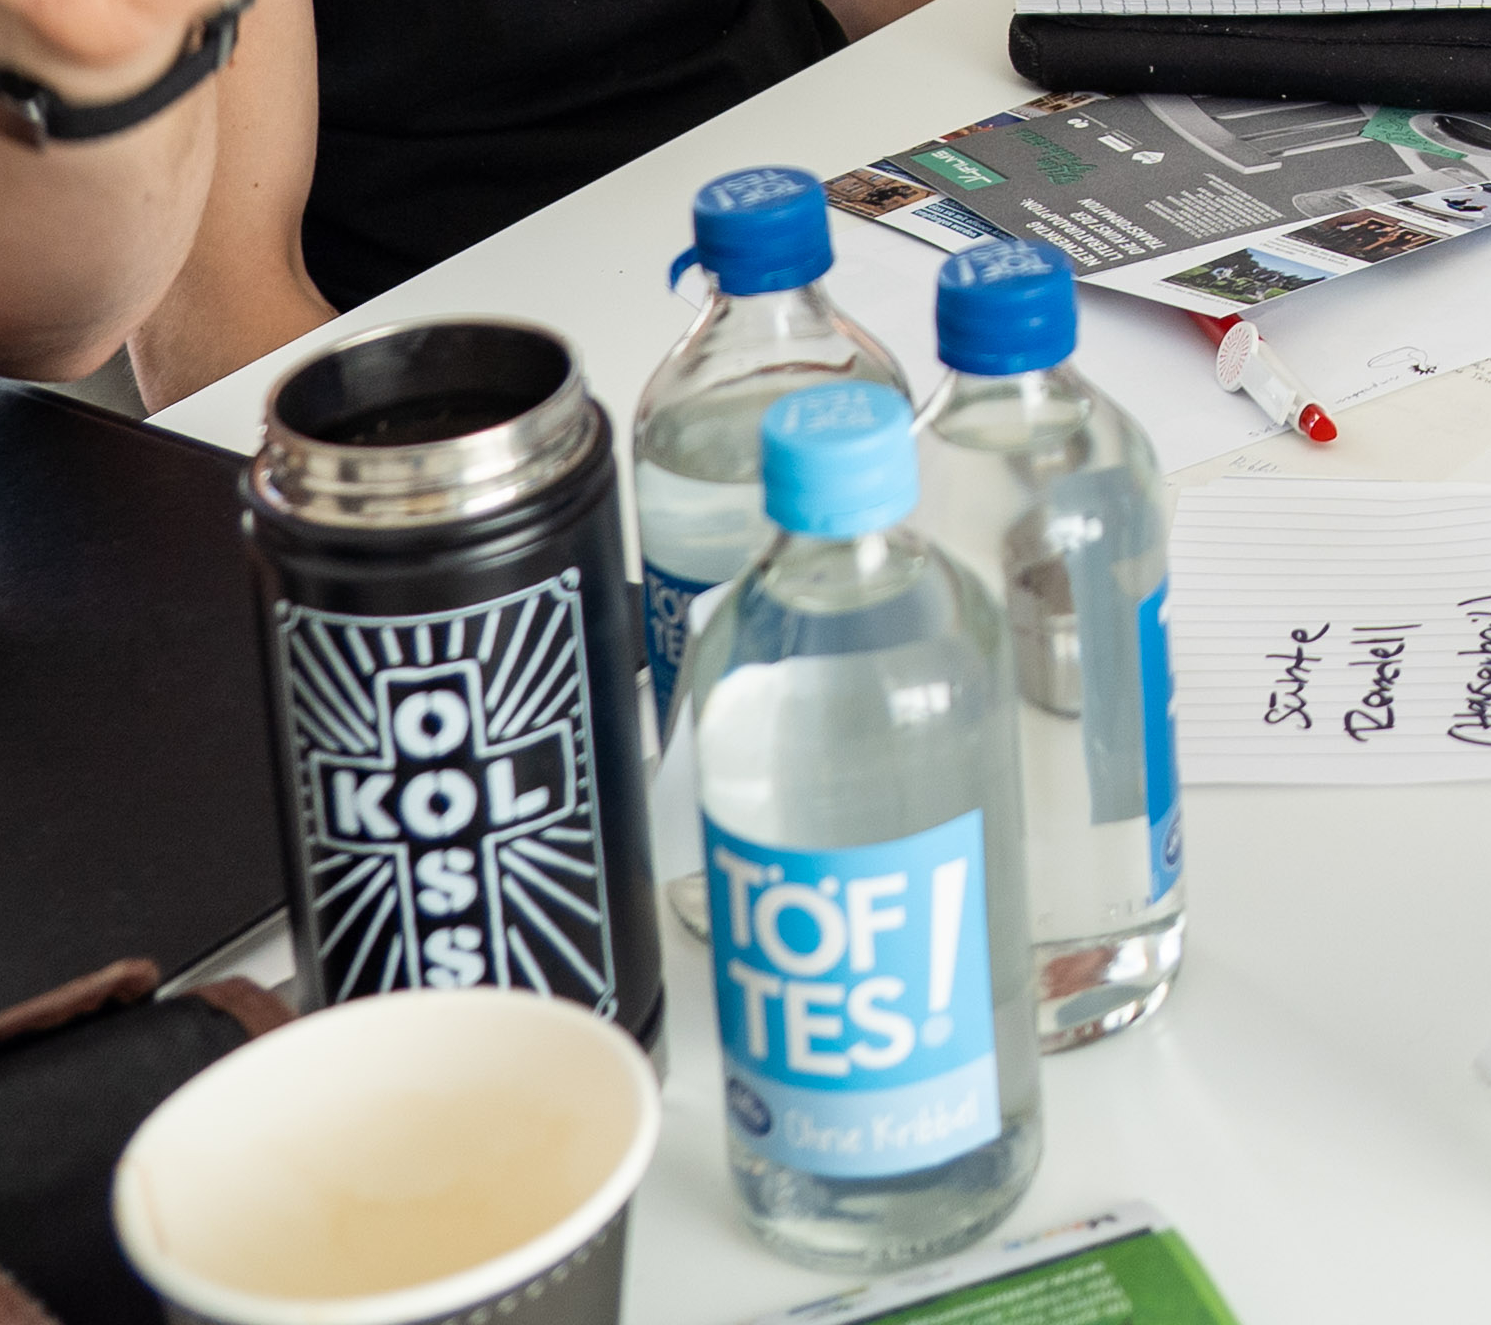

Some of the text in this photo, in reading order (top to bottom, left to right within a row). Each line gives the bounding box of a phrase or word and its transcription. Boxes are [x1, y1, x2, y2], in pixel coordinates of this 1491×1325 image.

[1025, 221, 1104, 268] NETZWERKTAG
[1068, 211, 1147, 256] DIE KUNST DER
[1076, 196, 1168, 251] TRANSFORMATION
[714, 844, 908, 979] TÖF
